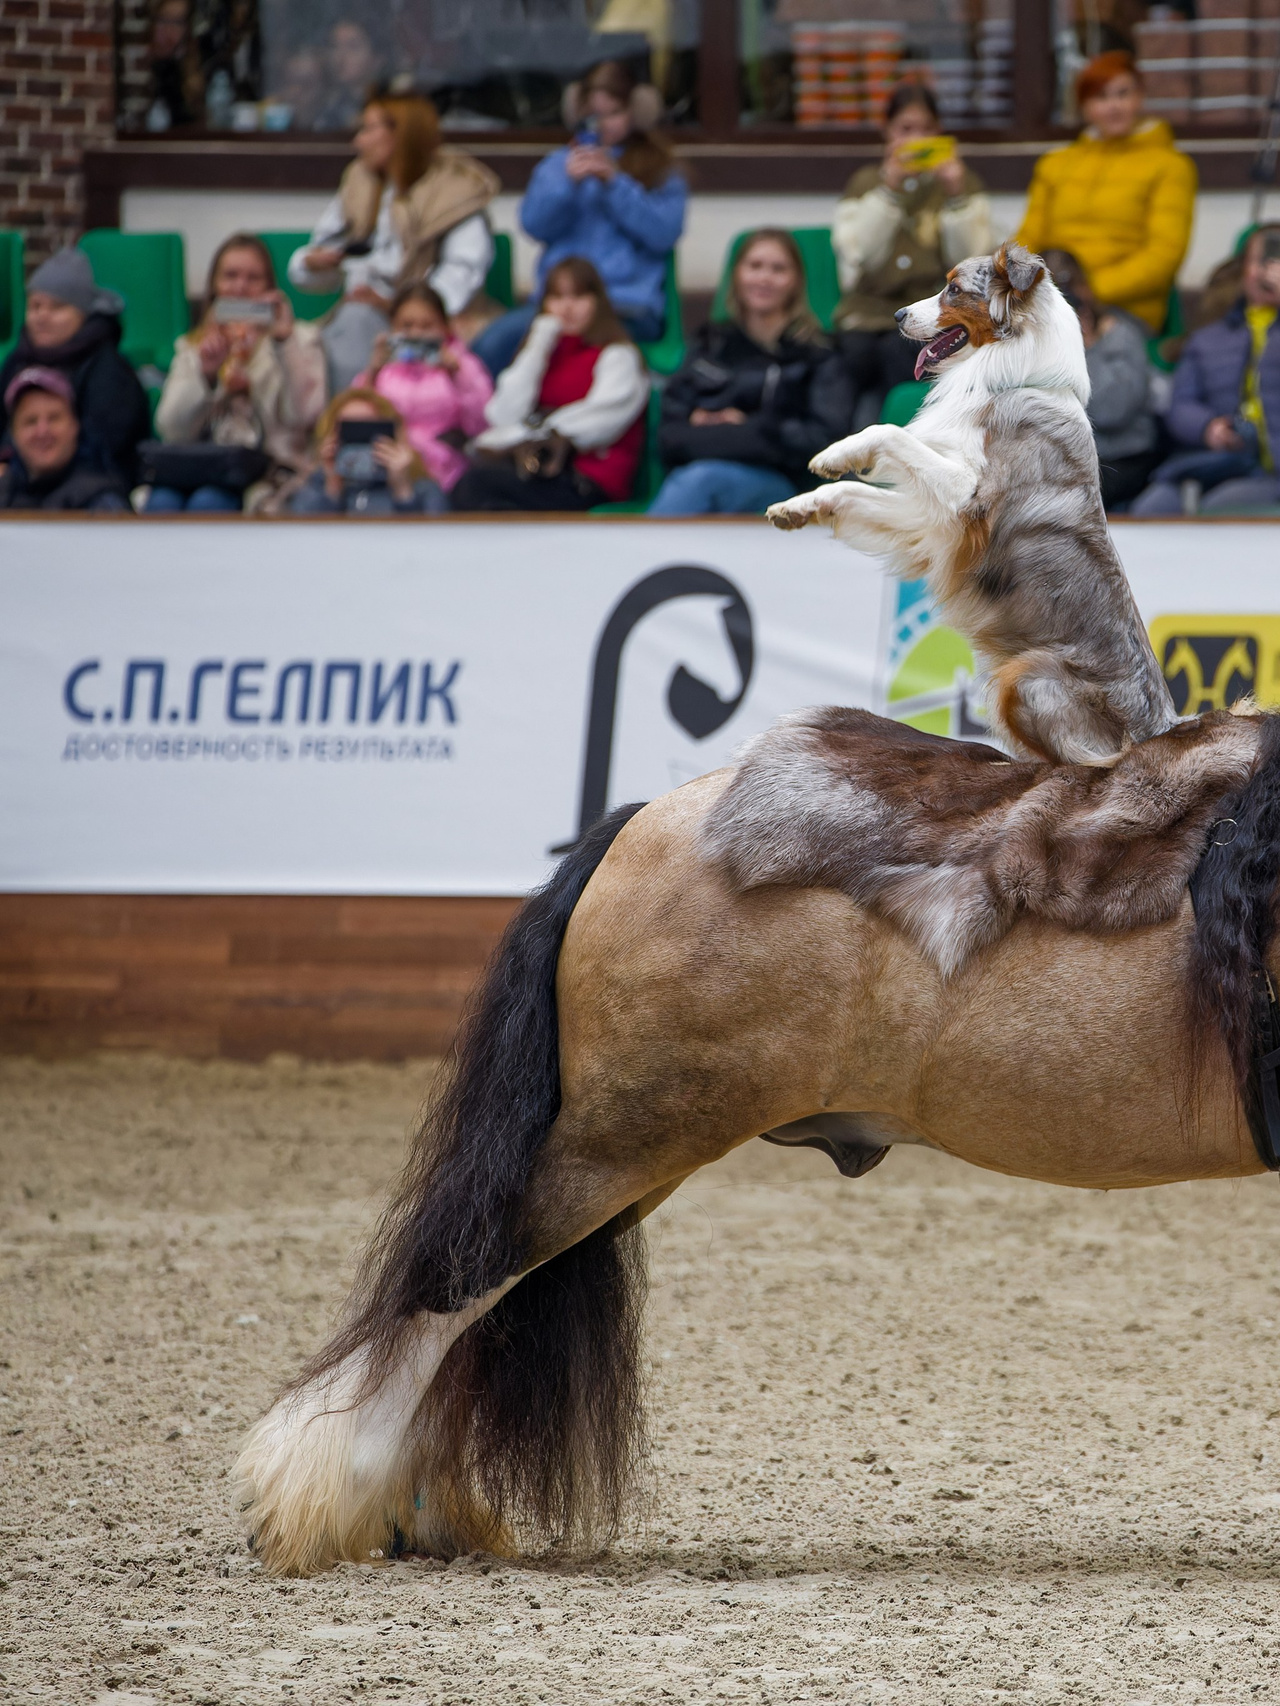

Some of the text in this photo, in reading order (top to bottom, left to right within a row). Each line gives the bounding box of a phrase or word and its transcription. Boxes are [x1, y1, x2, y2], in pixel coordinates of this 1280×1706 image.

[62, 657, 462, 724] С.П.ГЕЛПИК
[62, 734, 455, 763] ДОСТОВЕРНОСТЬ РЕЗУЛЬТАТА
